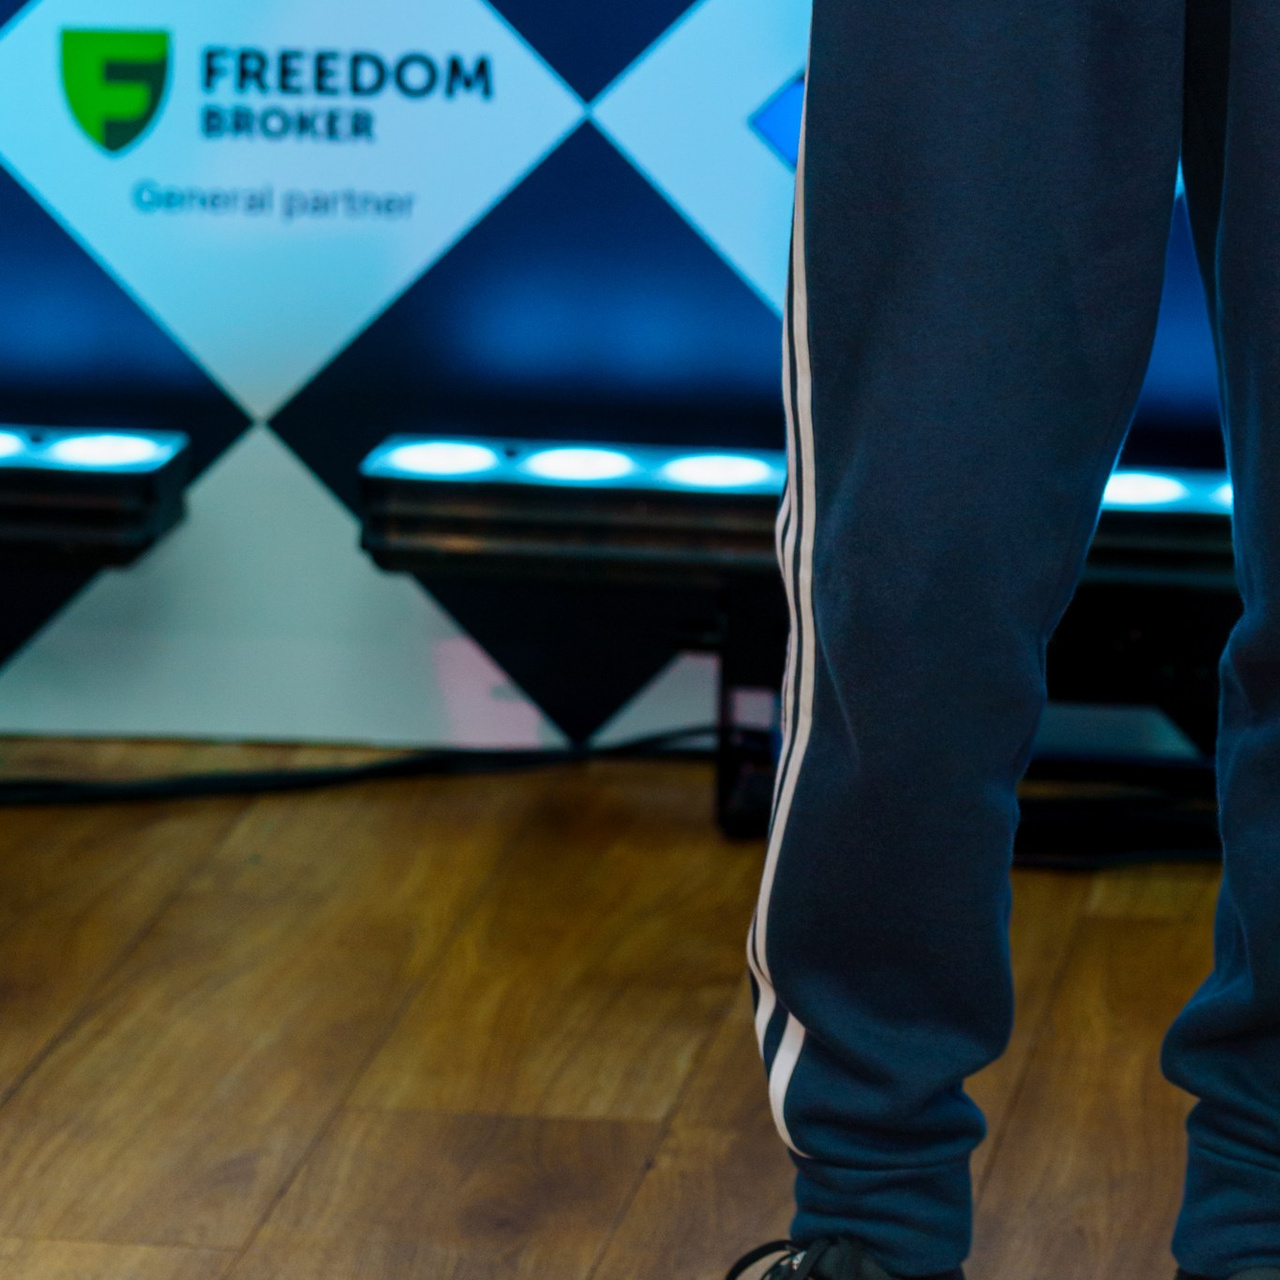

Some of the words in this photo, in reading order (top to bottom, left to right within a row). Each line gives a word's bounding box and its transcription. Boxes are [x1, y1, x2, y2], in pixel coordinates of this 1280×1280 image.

[201, 48, 494, 101] FREEDOM
[200, 106, 377, 143] BROKER
[131, 180, 273, 215] General
[282, 184, 415, 222] partner
